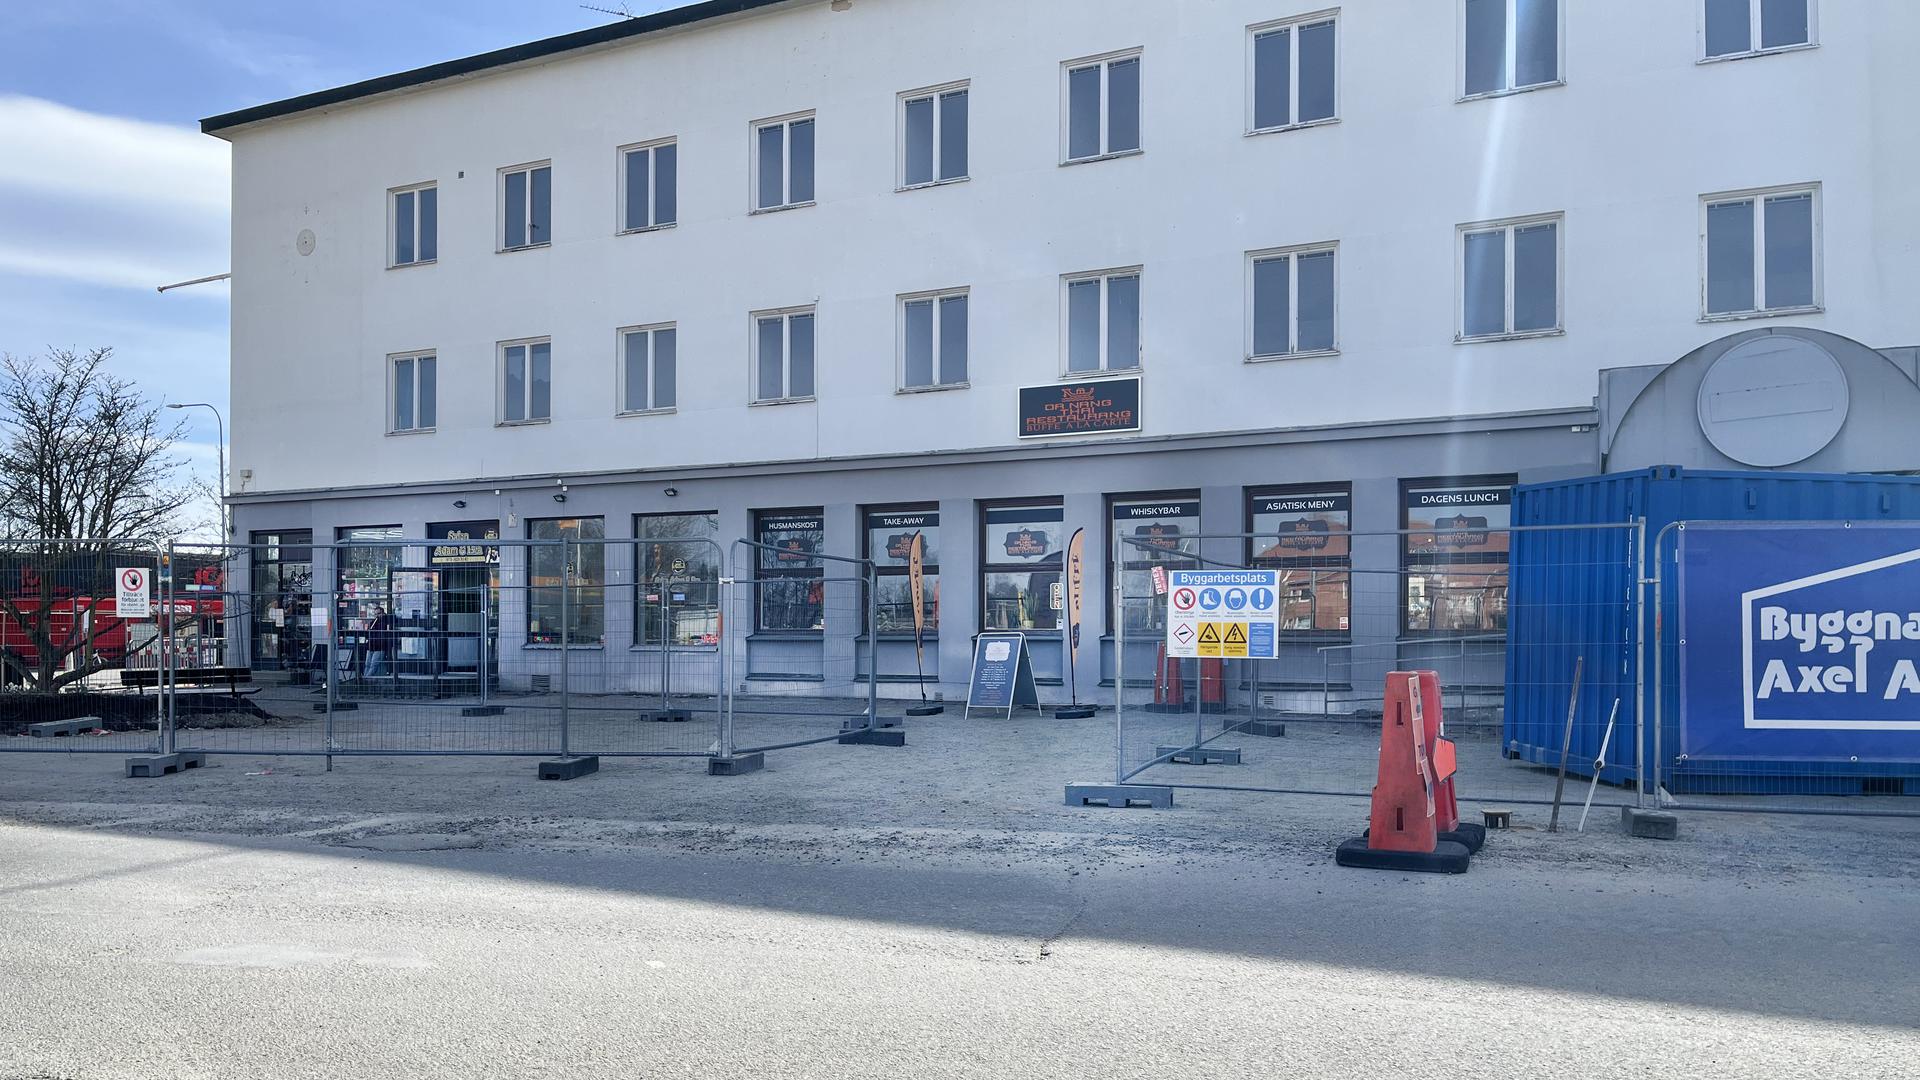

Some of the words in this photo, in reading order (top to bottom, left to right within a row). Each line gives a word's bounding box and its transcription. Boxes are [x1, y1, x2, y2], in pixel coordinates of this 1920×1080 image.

[1044, 403, 1065, 411] DA
[1068, 399, 1112, 409] NANG
[1060, 407, 1096, 416] THAI
[1026, 410, 1132, 425] RESTAURANG
[1421, 494, 1463, 504] DAGENS
[1464, 493, 1499, 502] LUNCH
[1130, 506, 1181, 516] WHISKYBAR
[1265, 501, 1307, 511] ASIATISK
[1308, 500, 1335, 509] MENY
[768, 521, 819, 530] HUSMANSKOST
[883, 516, 925, 526] TAKE-AWAY
[1181, 573, 1267, 585] Byggarbetsplats
[1756, 652, 1868, 699] Axel
